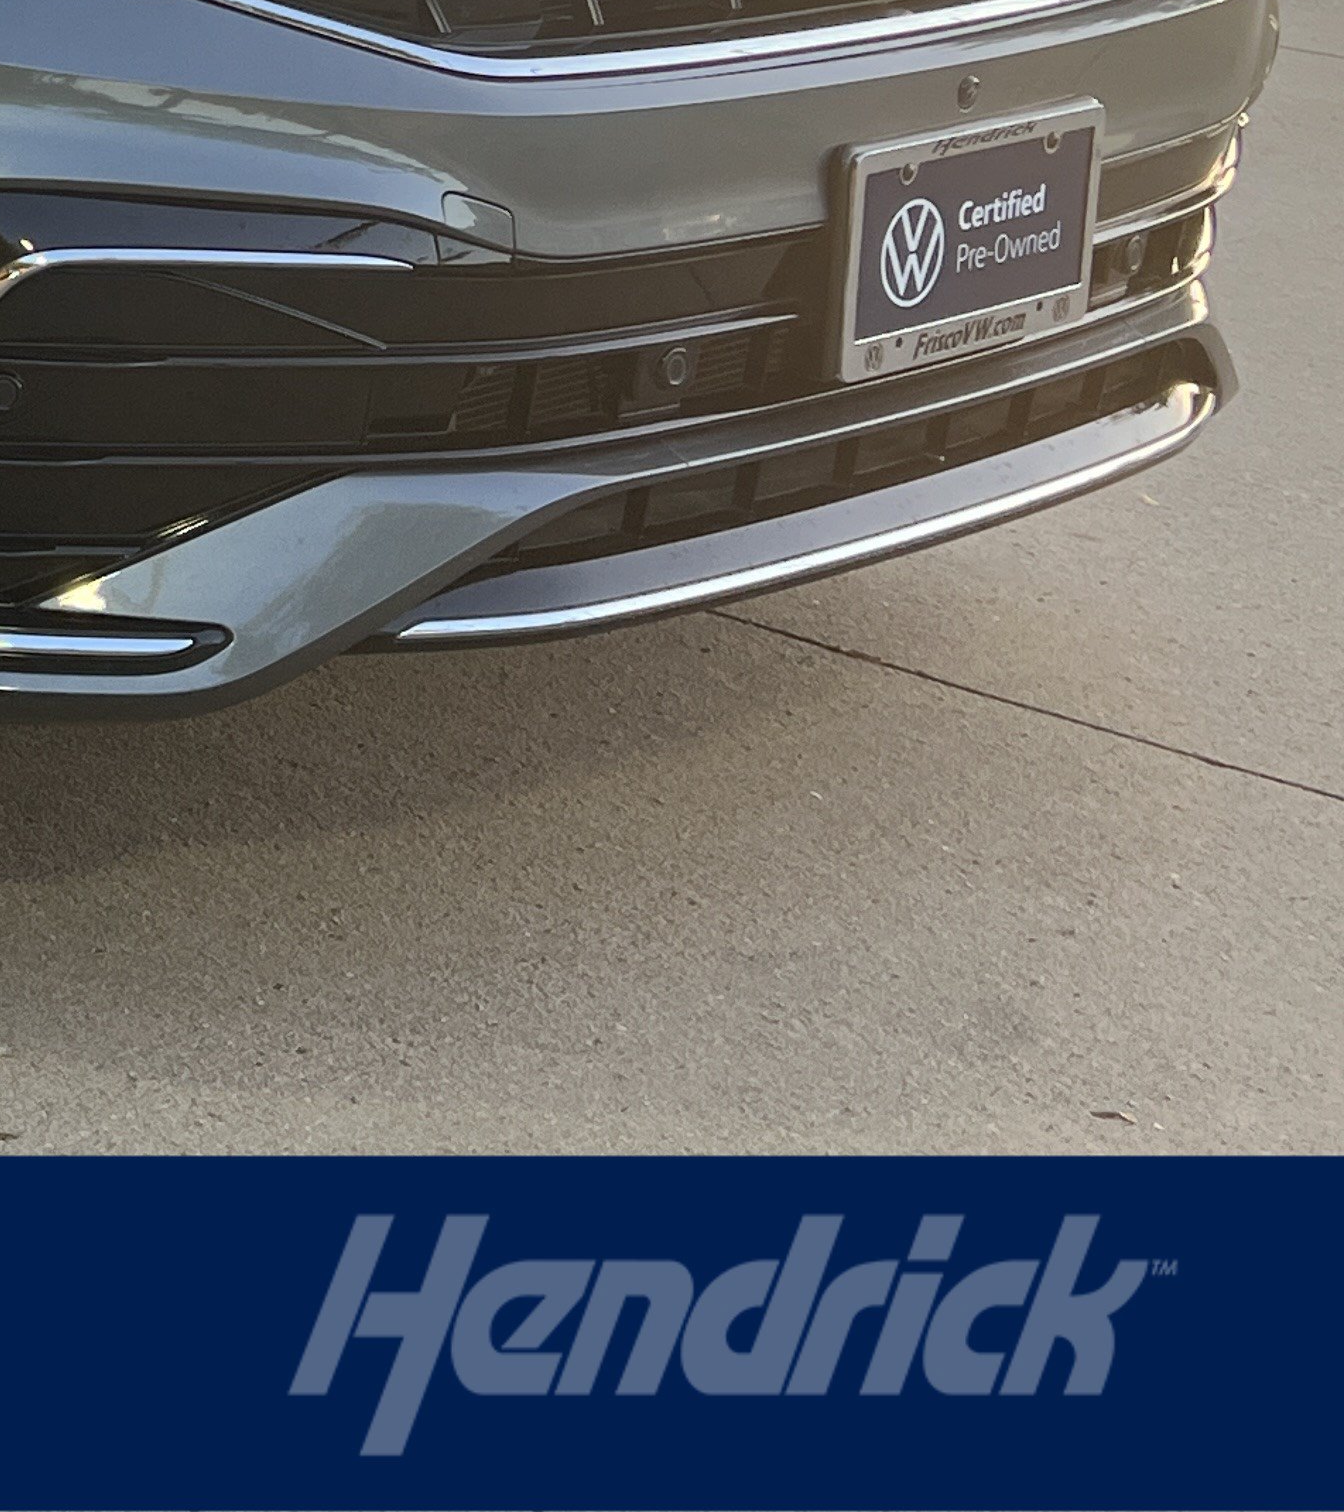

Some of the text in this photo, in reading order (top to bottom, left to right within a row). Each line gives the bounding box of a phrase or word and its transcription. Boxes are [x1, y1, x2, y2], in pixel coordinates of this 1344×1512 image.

[931, 122, 1037, 156] Hendrick
[958, 183, 1047, 231] Certified
[955, 220, 1061, 274] Pre-Owned
[912, 312, 1026, 360] FriscoVW.com
